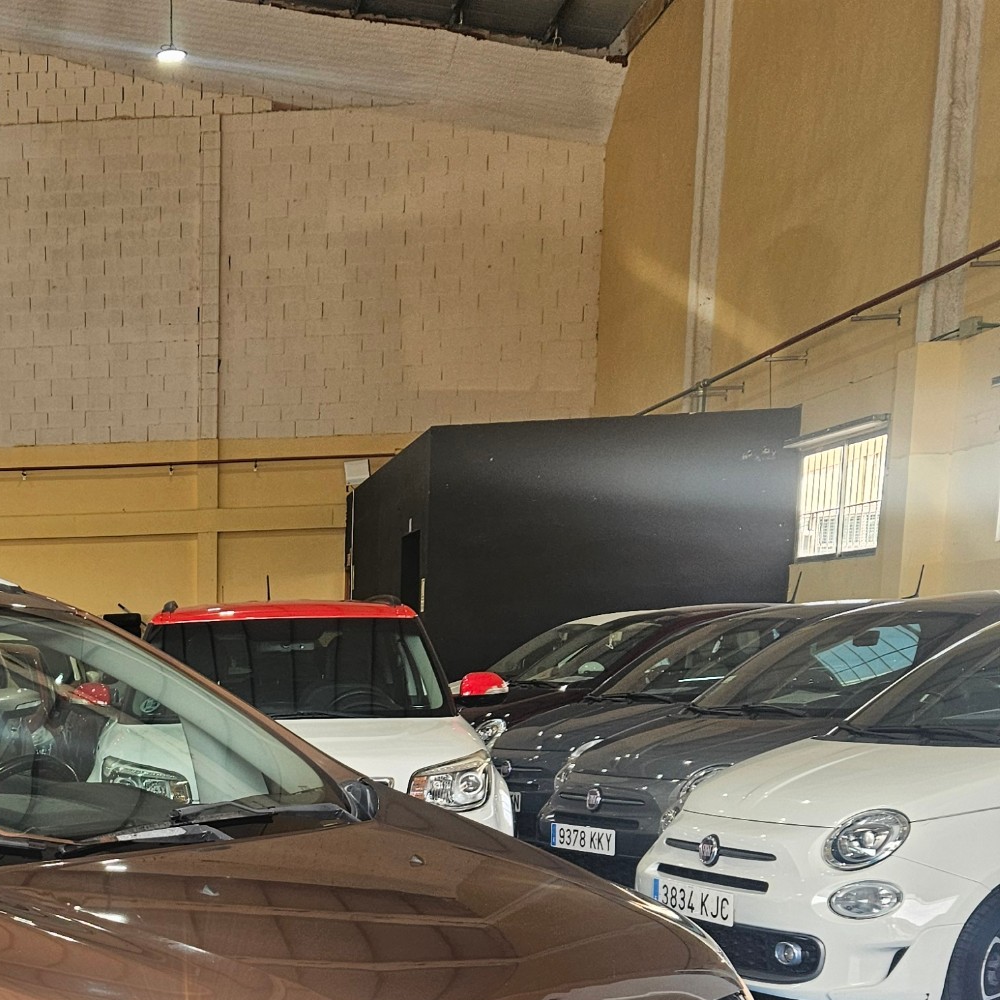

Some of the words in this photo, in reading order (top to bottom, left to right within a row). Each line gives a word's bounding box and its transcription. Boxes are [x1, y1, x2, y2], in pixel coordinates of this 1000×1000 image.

[558, 827, 586, 848] 9378
[589, 831, 613, 851] KKY
[661, 884, 695, 913] 3834
[700, 892, 729, 921] KJC
